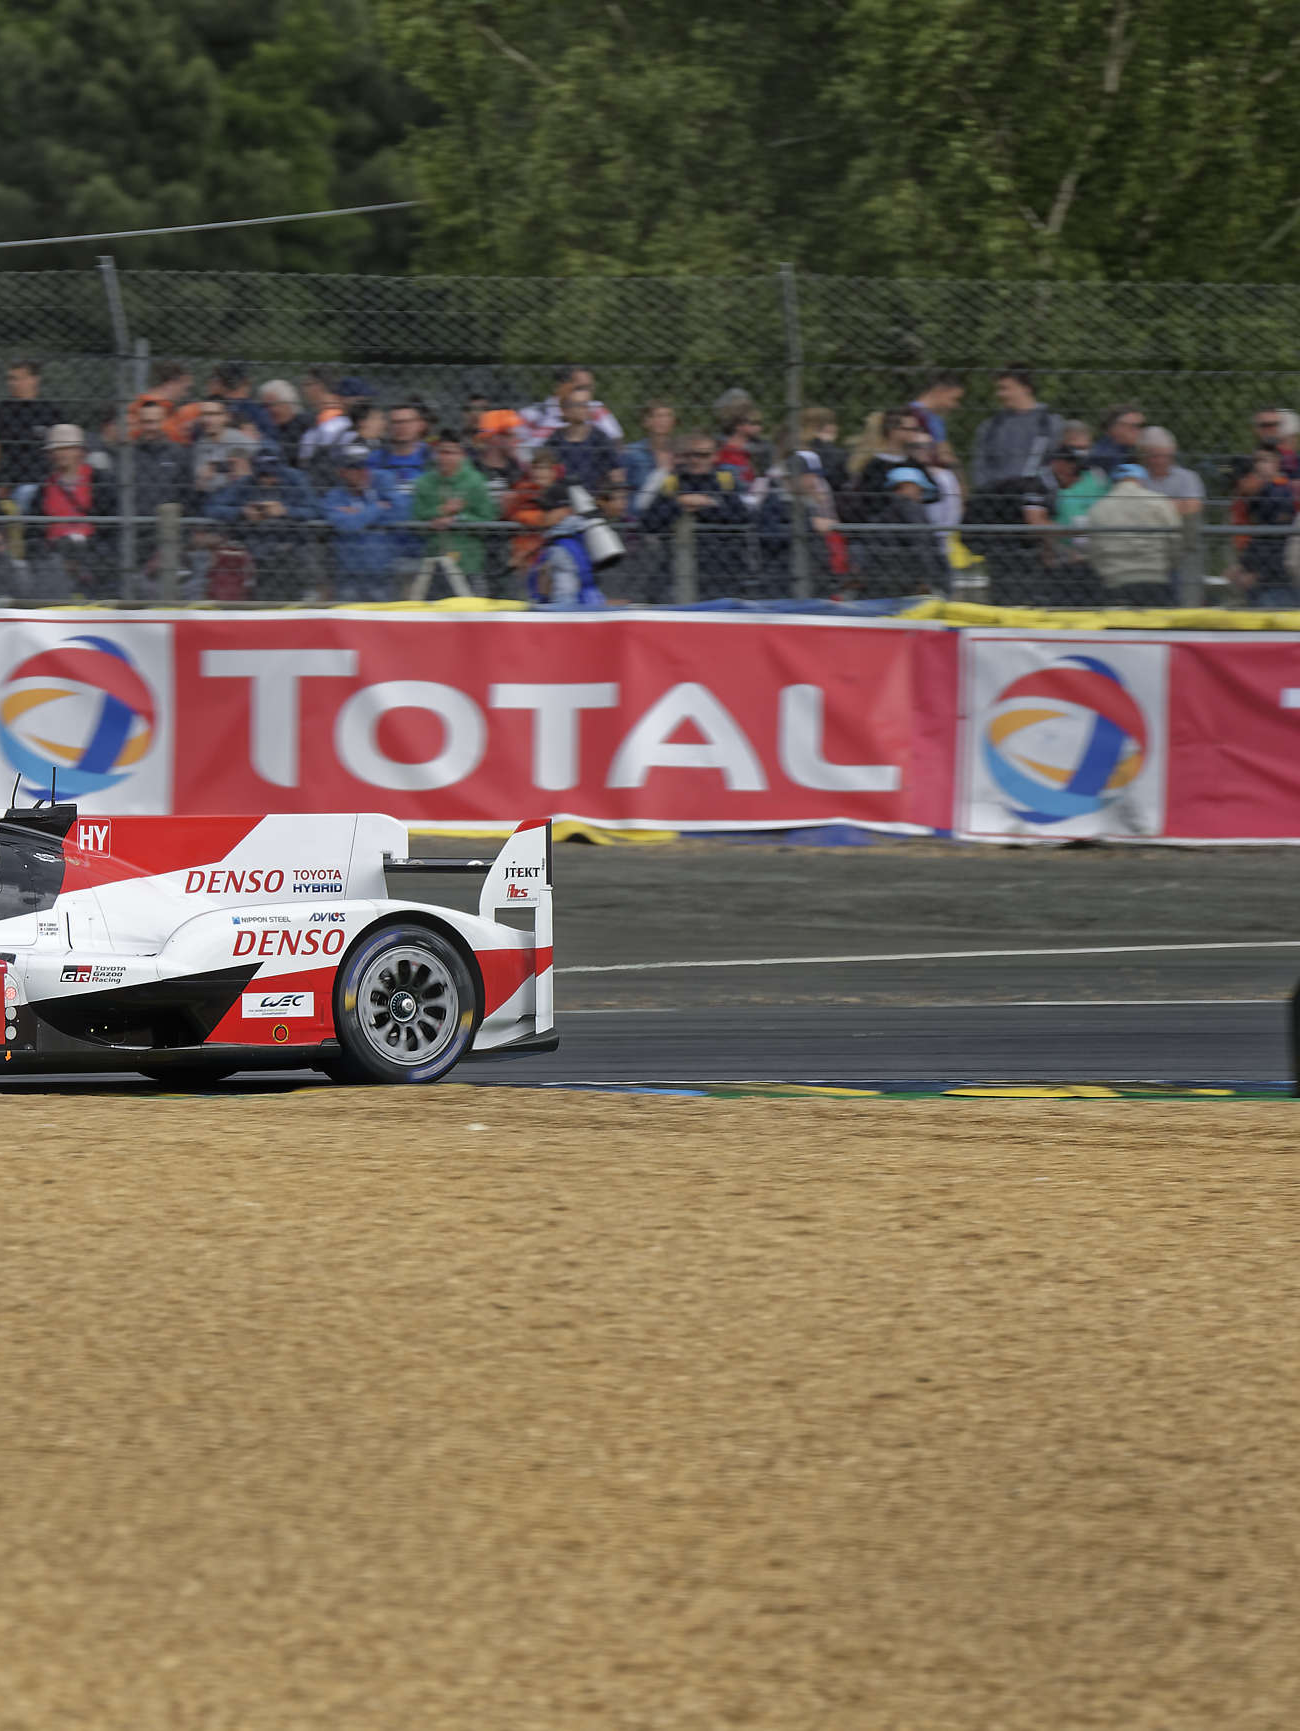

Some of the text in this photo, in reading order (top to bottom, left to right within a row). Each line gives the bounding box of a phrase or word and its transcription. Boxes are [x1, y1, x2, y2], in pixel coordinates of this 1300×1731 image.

[200, 648, 901, 792] TOTAL
[80, 825, 108, 851] HY
[293, 869, 342, 881] TOYOTA
[504, 867, 540, 880] JTEKT
[185, 869, 285, 894] DENSO
[293, 883, 343, 893] HYBRID
[233, 929, 346, 957] DENSO
[61, 971, 91, 982] GR
[91, 977, 121, 985] Racing
[260, 995, 305, 1008] WEC
